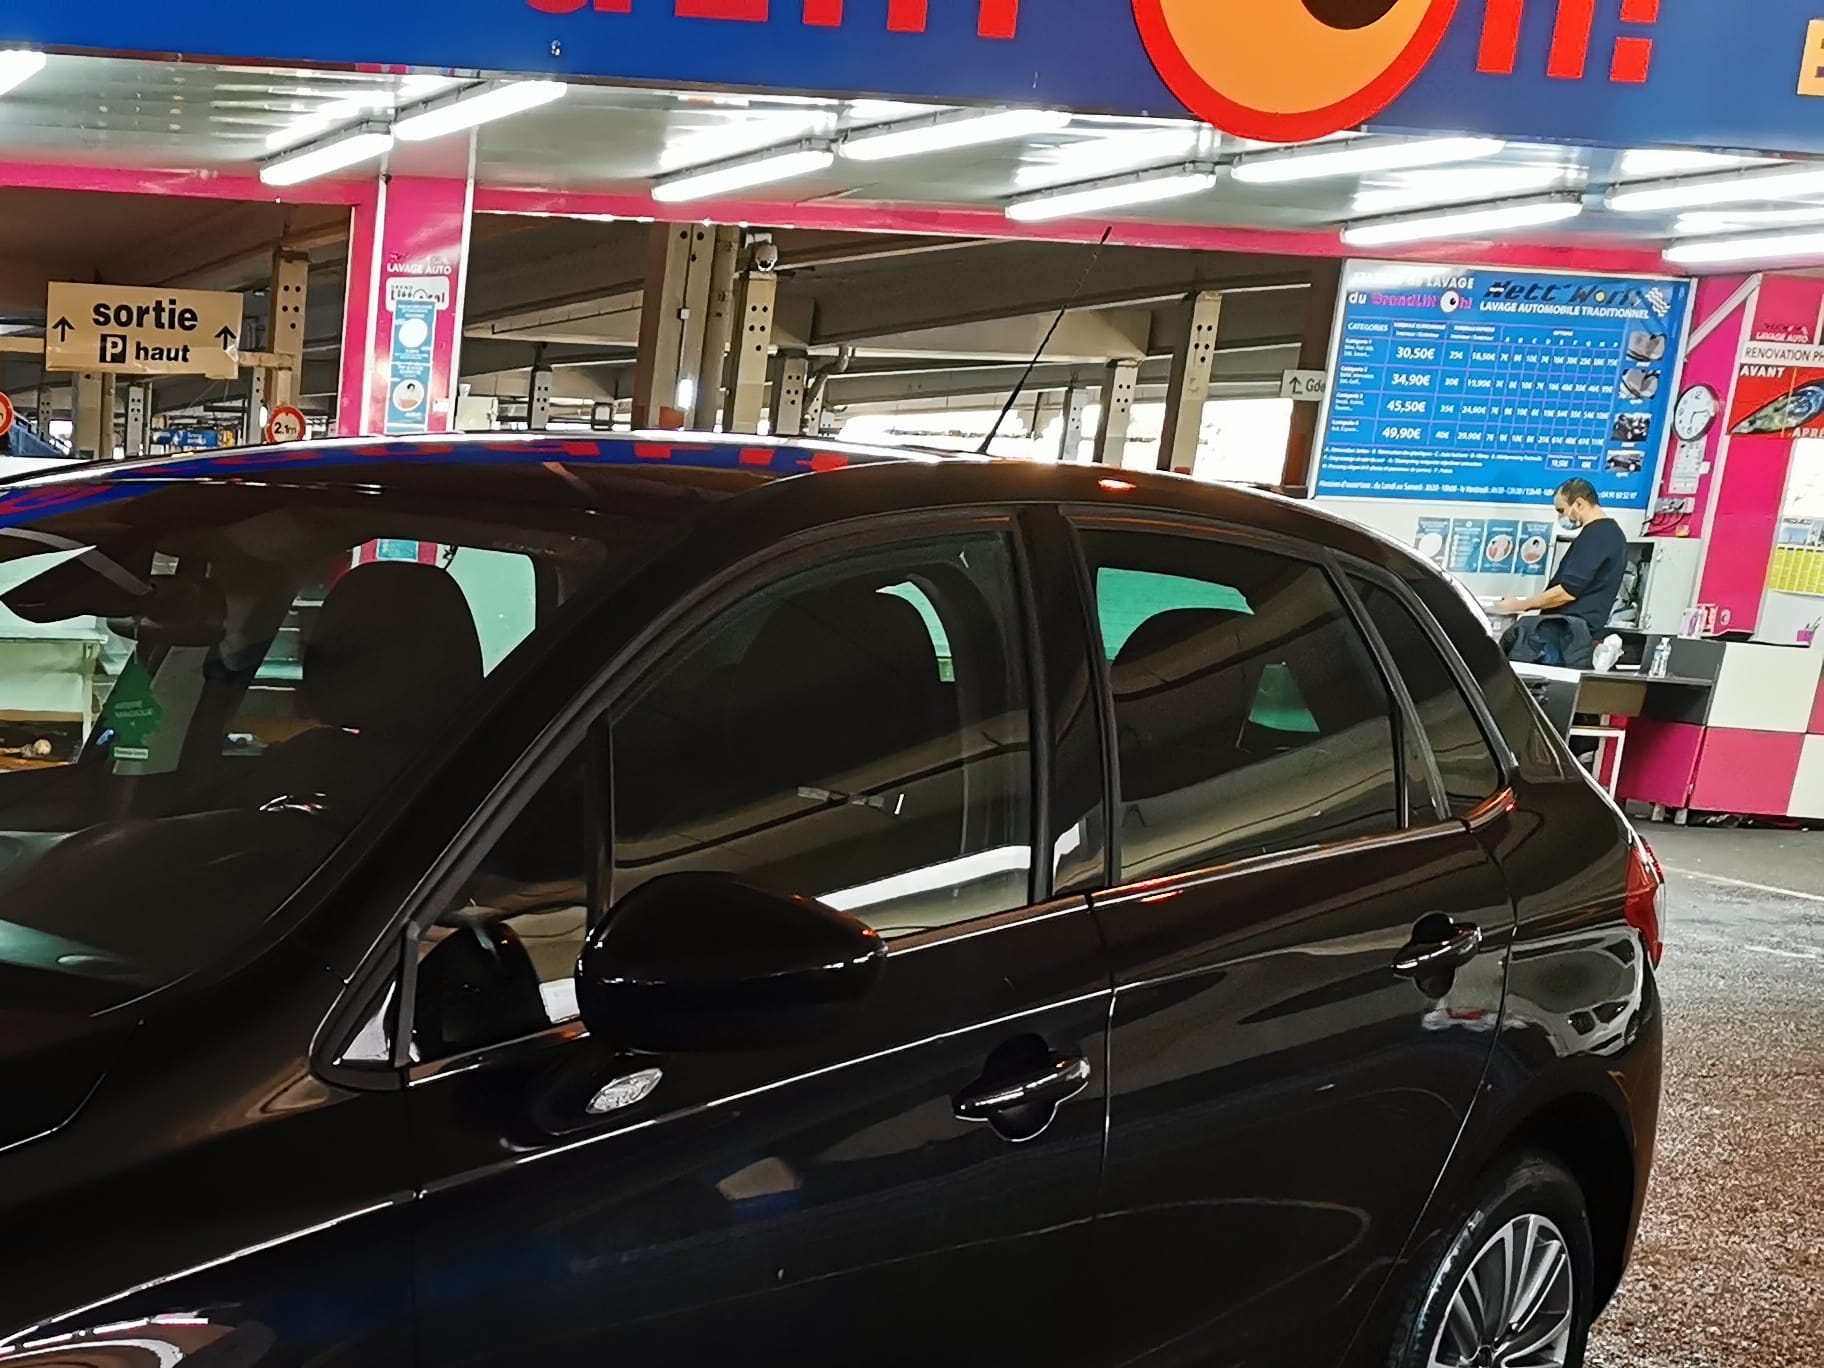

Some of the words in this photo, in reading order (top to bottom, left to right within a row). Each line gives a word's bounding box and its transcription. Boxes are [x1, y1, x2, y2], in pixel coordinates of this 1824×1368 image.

[386, 262, 423, 274] LAVAGE
[424, 265, 452, 275] AUTO
[1426, 277, 1476, 290] LAVAGE
[1348, 292, 1367, 304] du
[92, 299, 198, 331] sortie
[1479, 300, 1517, 313] LAVAGE
[1517, 303, 1581, 317] AUTOMOBILE
[1581, 306, 1650, 320] TRADITIONNEL
[105, 336, 122, 361] P
[135, 341, 190, 363] haut
[1395, 346, 1436, 361] 30,50€
[1745, 346, 1811, 361] RENOVATION
[1740, 365, 1785, 378] AVANT
[1391, 373, 1432, 387] 34,90€
[1386, 399, 1427, 413] 45,50€
[1381, 426, 1422, 441] 49,90€
